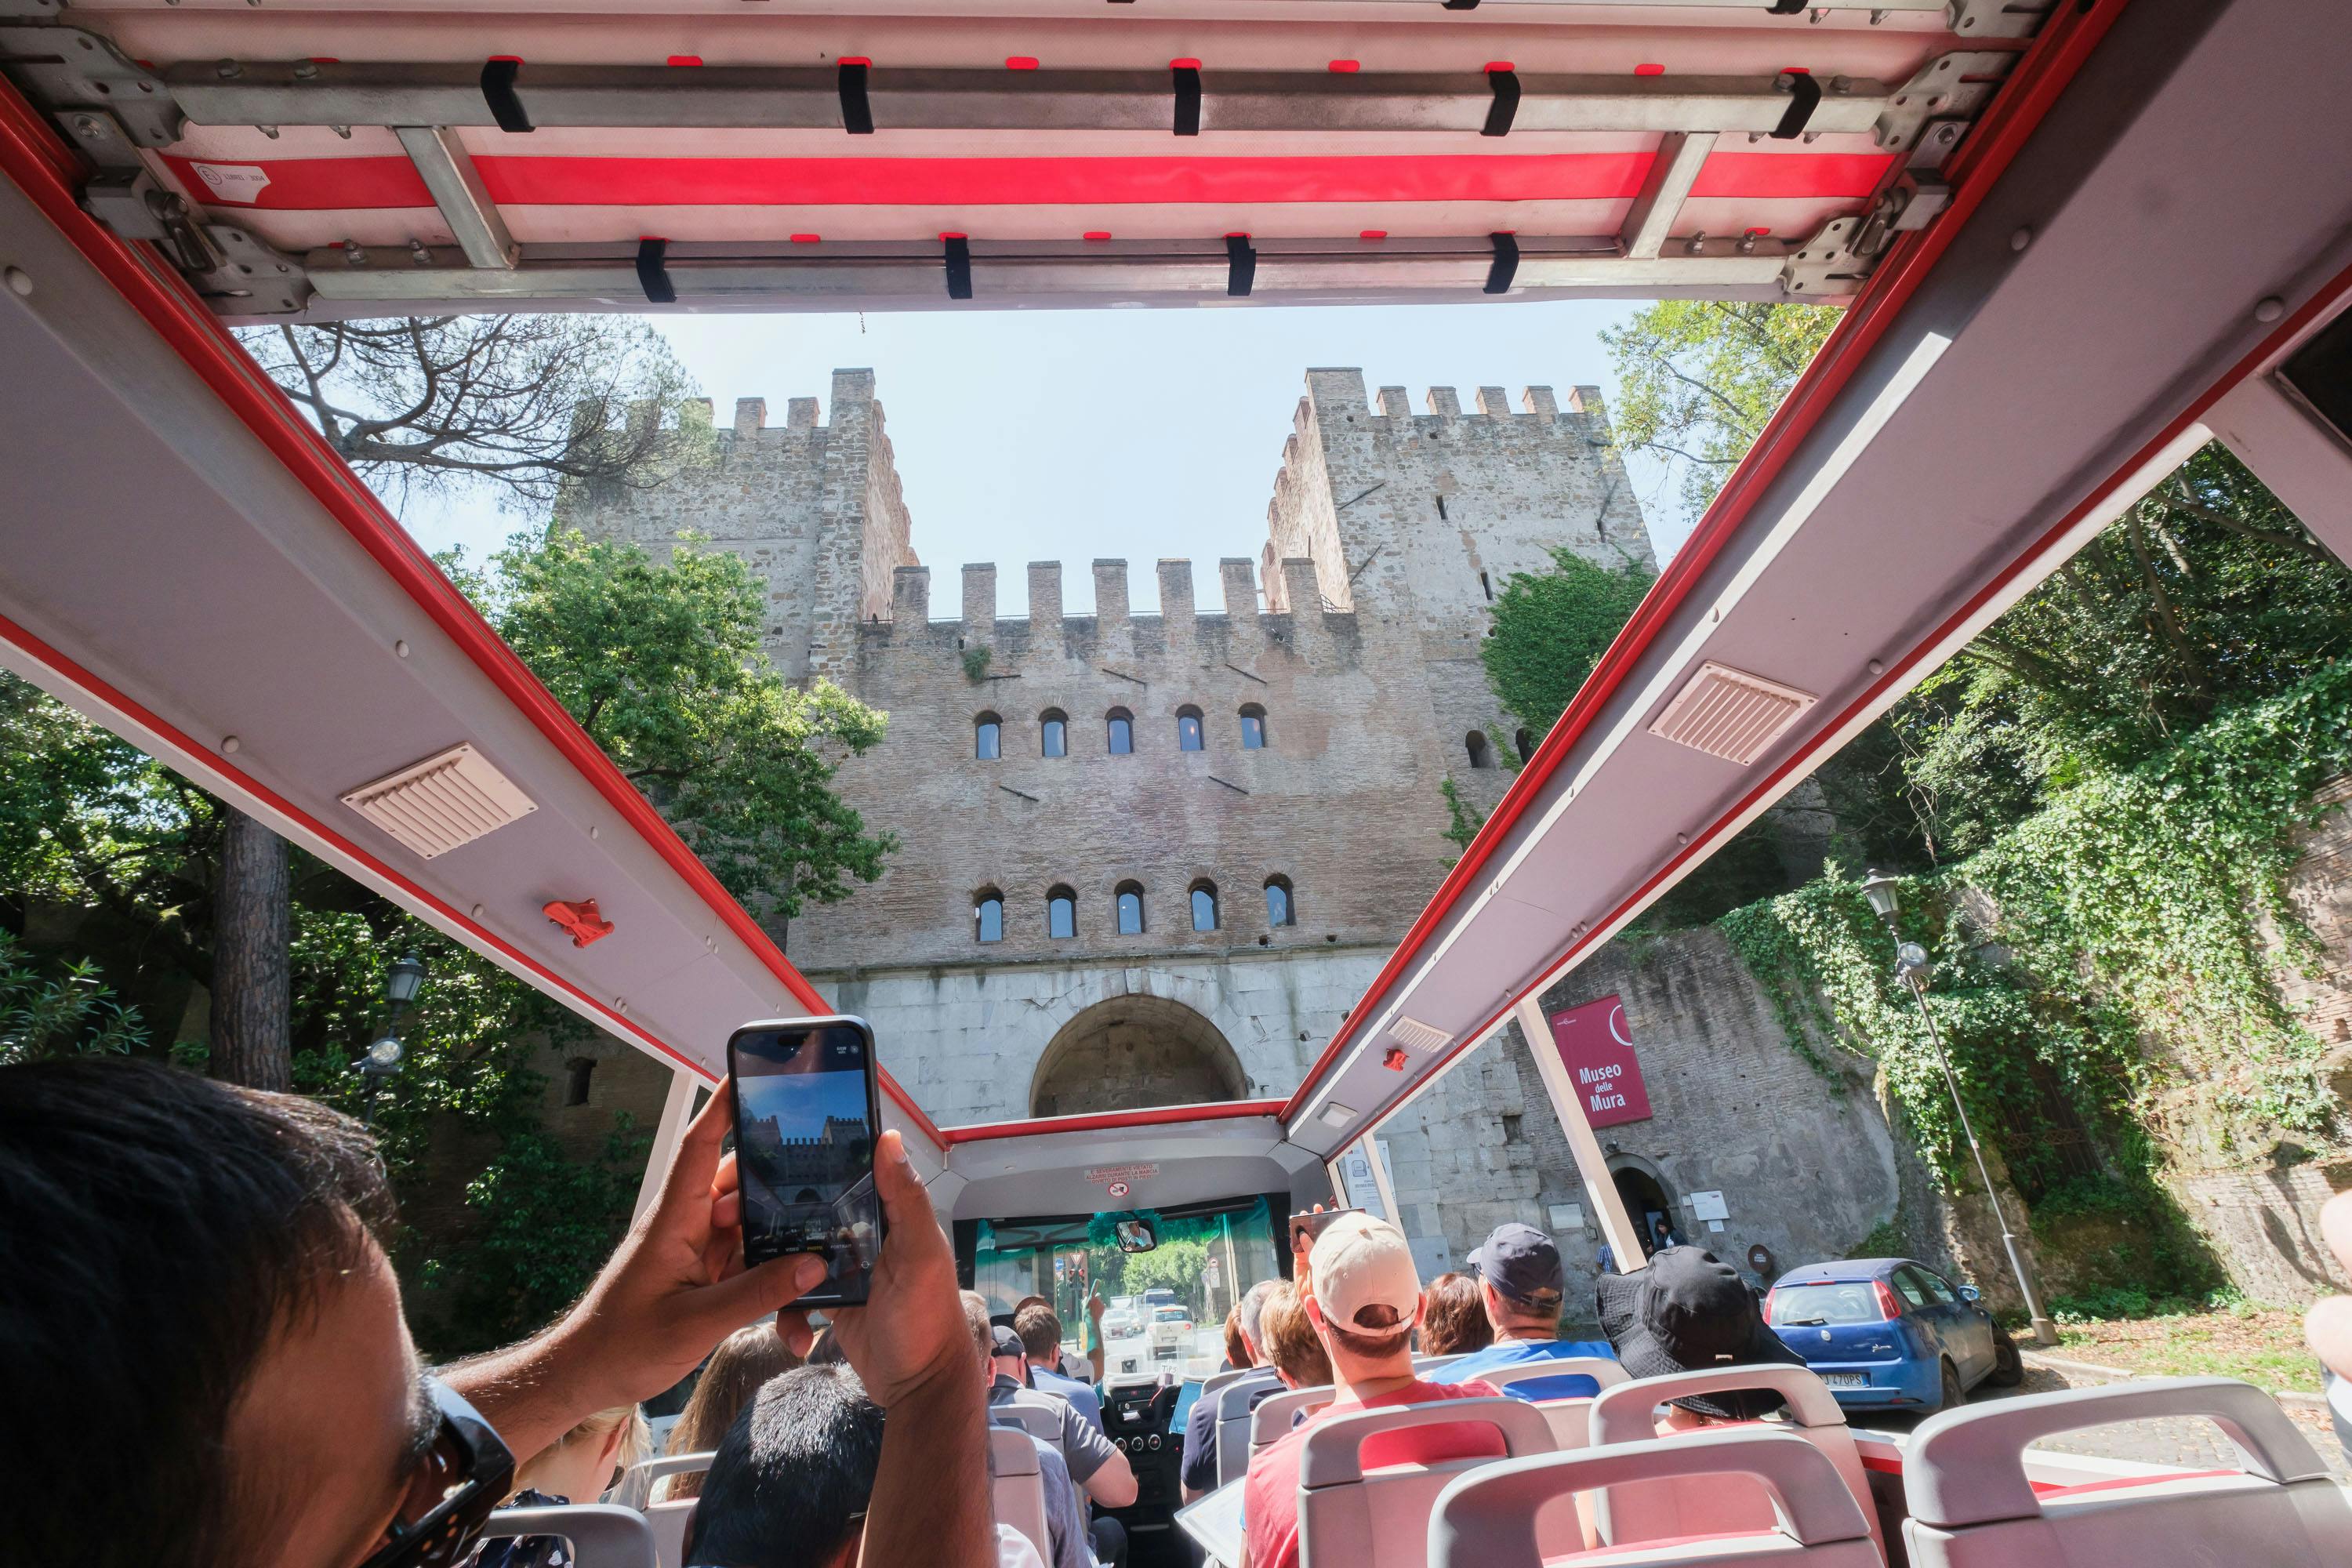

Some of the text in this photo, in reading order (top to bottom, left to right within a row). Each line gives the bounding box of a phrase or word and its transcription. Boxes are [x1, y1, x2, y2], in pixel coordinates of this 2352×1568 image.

[1579, 1064, 1622, 1084] Museo
[1595, 1081, 1613, 1094] delle
[1590, 1094, 1626, 1112] Mura
